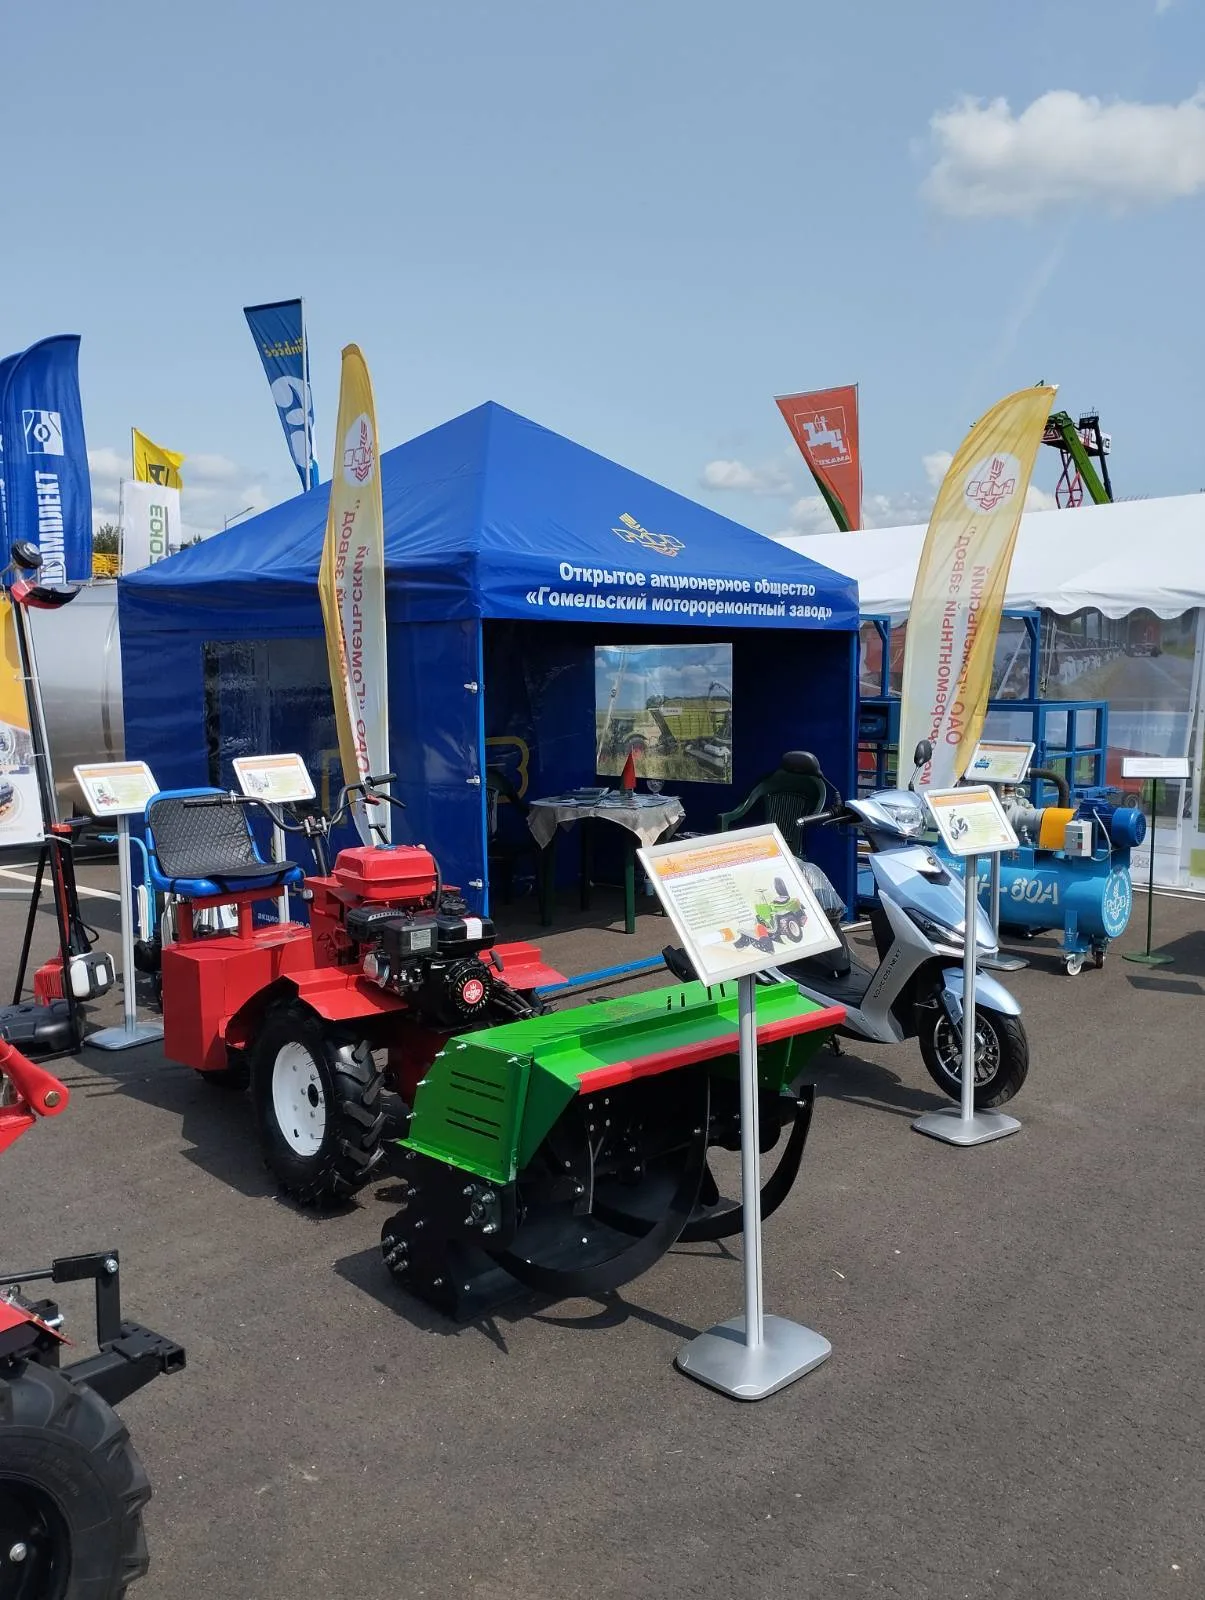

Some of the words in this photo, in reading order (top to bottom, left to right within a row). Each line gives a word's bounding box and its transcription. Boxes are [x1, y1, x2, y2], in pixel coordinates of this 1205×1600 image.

[149, 504, 164, 565] ОЮЗ
[559, 562, 646, 587] Открытое
[650, 572, 750, 594] акционерное
[754, 578, 816, 598] общество
[526, 586, 647, 611] «Гомельский
[651, 598, 785, 617] мотороремонтный
[789, 603, 833, 621] завод»
